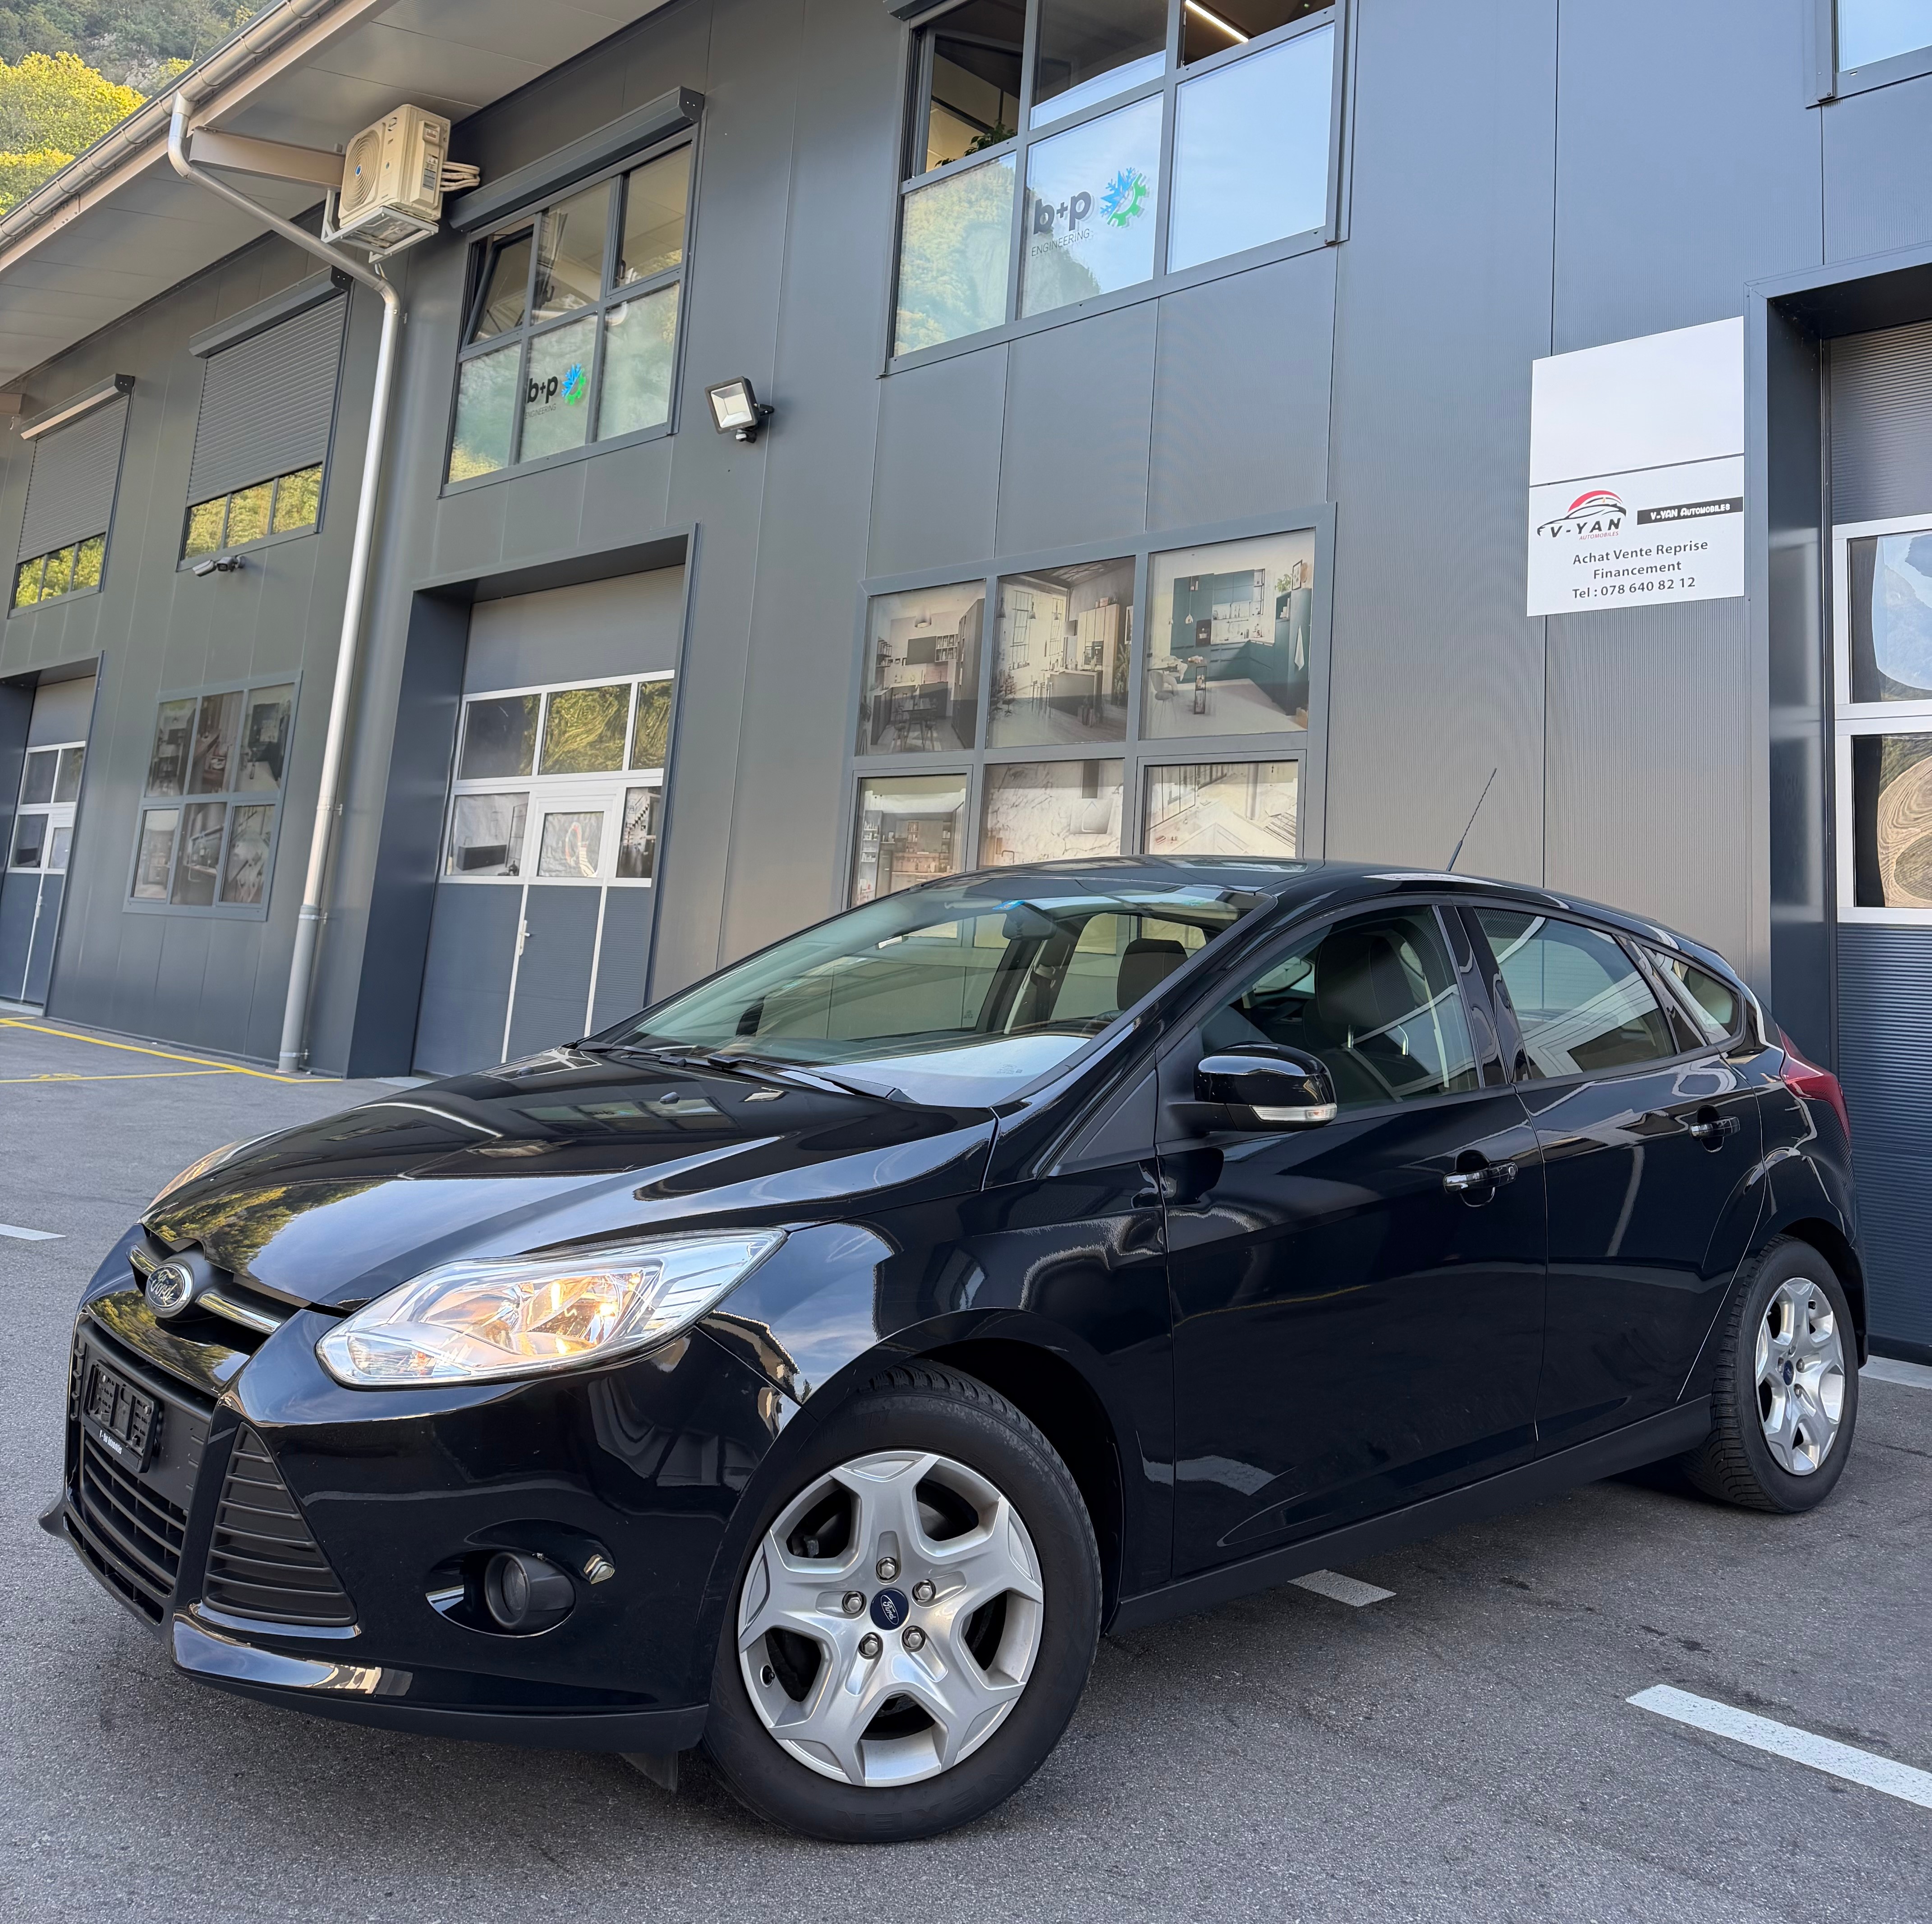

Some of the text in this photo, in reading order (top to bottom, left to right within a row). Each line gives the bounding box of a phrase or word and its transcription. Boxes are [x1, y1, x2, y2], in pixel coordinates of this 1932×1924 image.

[1033, 191, 1091, 234] b+p
[1031, 228, 1090, 257] ENGINEERING
[527, 376, 558, 404] b+p
[525, 404, 556, 419] ENGINEERING
[1650, 509, 1678, 520] V-YAN
[1579, 531, 1619, 540] AUTOMOBILES
[1573, 540, 1708, 565] Achat Vente Reprise
[1594, 561, 1682, 579] Financement
[1601, 584, 1625, 596] 078
[1629, 582, 1654, 592] 640
[1658, 579, 1674, 590] 82
[1679, 577, 1695, 588] 12
[151, 1269, 177, 1306] Ford
[882, 1601, 897, 1620] Ford
